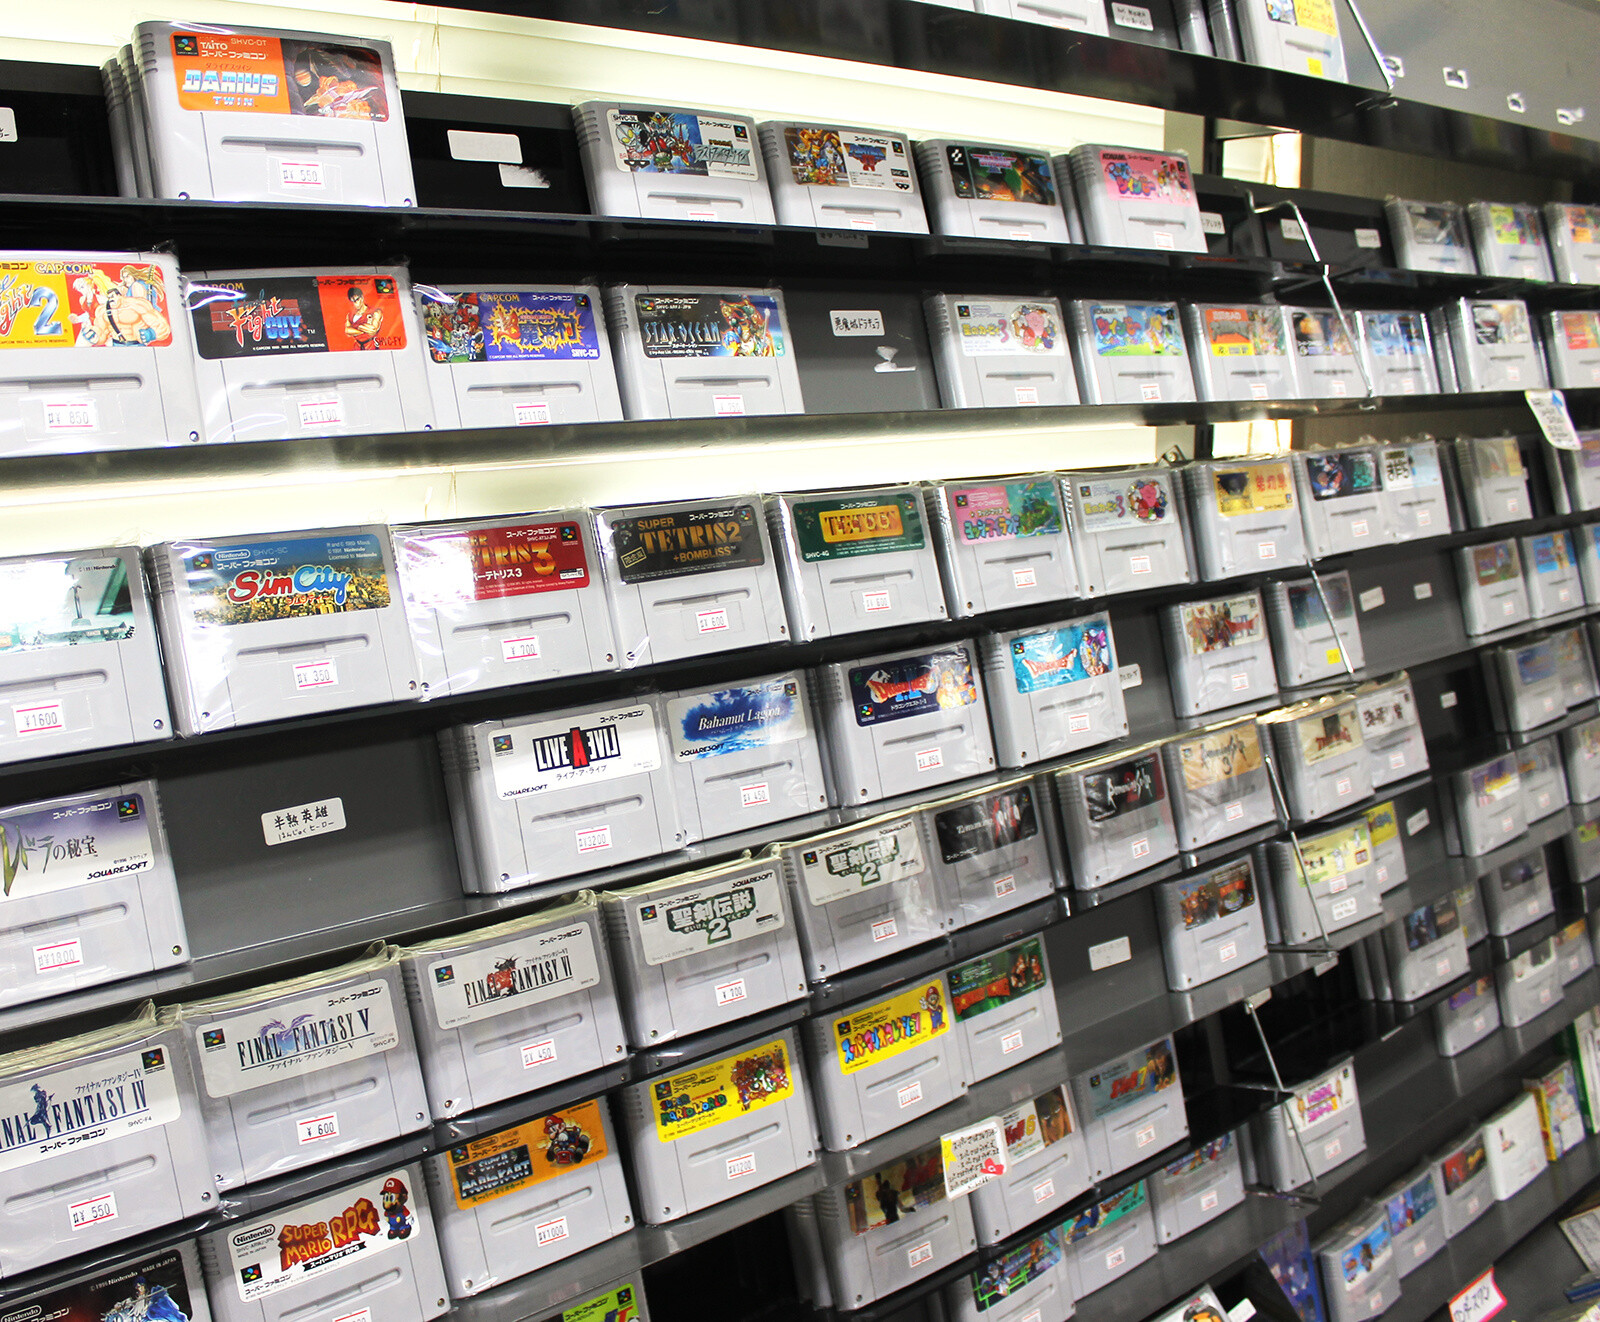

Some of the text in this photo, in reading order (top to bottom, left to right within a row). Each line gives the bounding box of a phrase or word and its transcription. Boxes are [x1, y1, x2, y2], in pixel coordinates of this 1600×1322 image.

[182, 70, 279, 96] DARIUS
[212, 96, 255, 107] TWIN
[34, 262, 94, 275] CAPCOM
[479, 293, 520, 303] CAPCOM
[265, 316, 302, 340] GUY
[644, 321, 722, 343] STAR OCEAN
[506, 527, 558, 539] スーパーファミコン
[637, 517, 676, 531] SUPER
[217, 550, 249, 560] Nintendo
[217, 557, 280, 571] スーパーファミコン
[600, 709, 645, 724] スーパーファミコン
[698, 704, 781, 732] Bahamut Lagoon
[535, 736, 571, 770] LIVE
[679, 742, 725, 758] SQUARESOFT
[502, 783, 548, 798] SQUARESOFT
[53, 801, 114, 820] スーパーファミコン
[274, 804, 329, 831] 半熟英雄
[87, 860, 149, 880] SQUARESOFT
[731, 871, 775, 890] SQUARESOFT
[861, 861, 880, 883] 2
[672, 889, 754, 931] 聖剣伝説
[709, 917, 730, 941] 2
[511, 958, 559, 995] FANTASY
[561, 955, 574, 978] VI
[327, 985, 384, 1008] スーパーファミコン
[237, 1007, 371, 1068] FINAL FANTASY V
[52, 1085, 127, 1134] FANTASY
[131, 1079, 148, 1110] IV
[659, 1093, 691, 1111] SUPER
[660, 1093, 728, 1127] MARIO WORLD
[1026, 1114, 1037, 1136] 6
[40, 1127, 108, 1154] スーパーファミコン
[283, 1199, 376, 1247] SUPER RPG
[236, 1226, 274, 1244] Nintendo
[286, 1238, 331, 1267] MARIO
[108, 1271, 138, 1287] Nintendo
